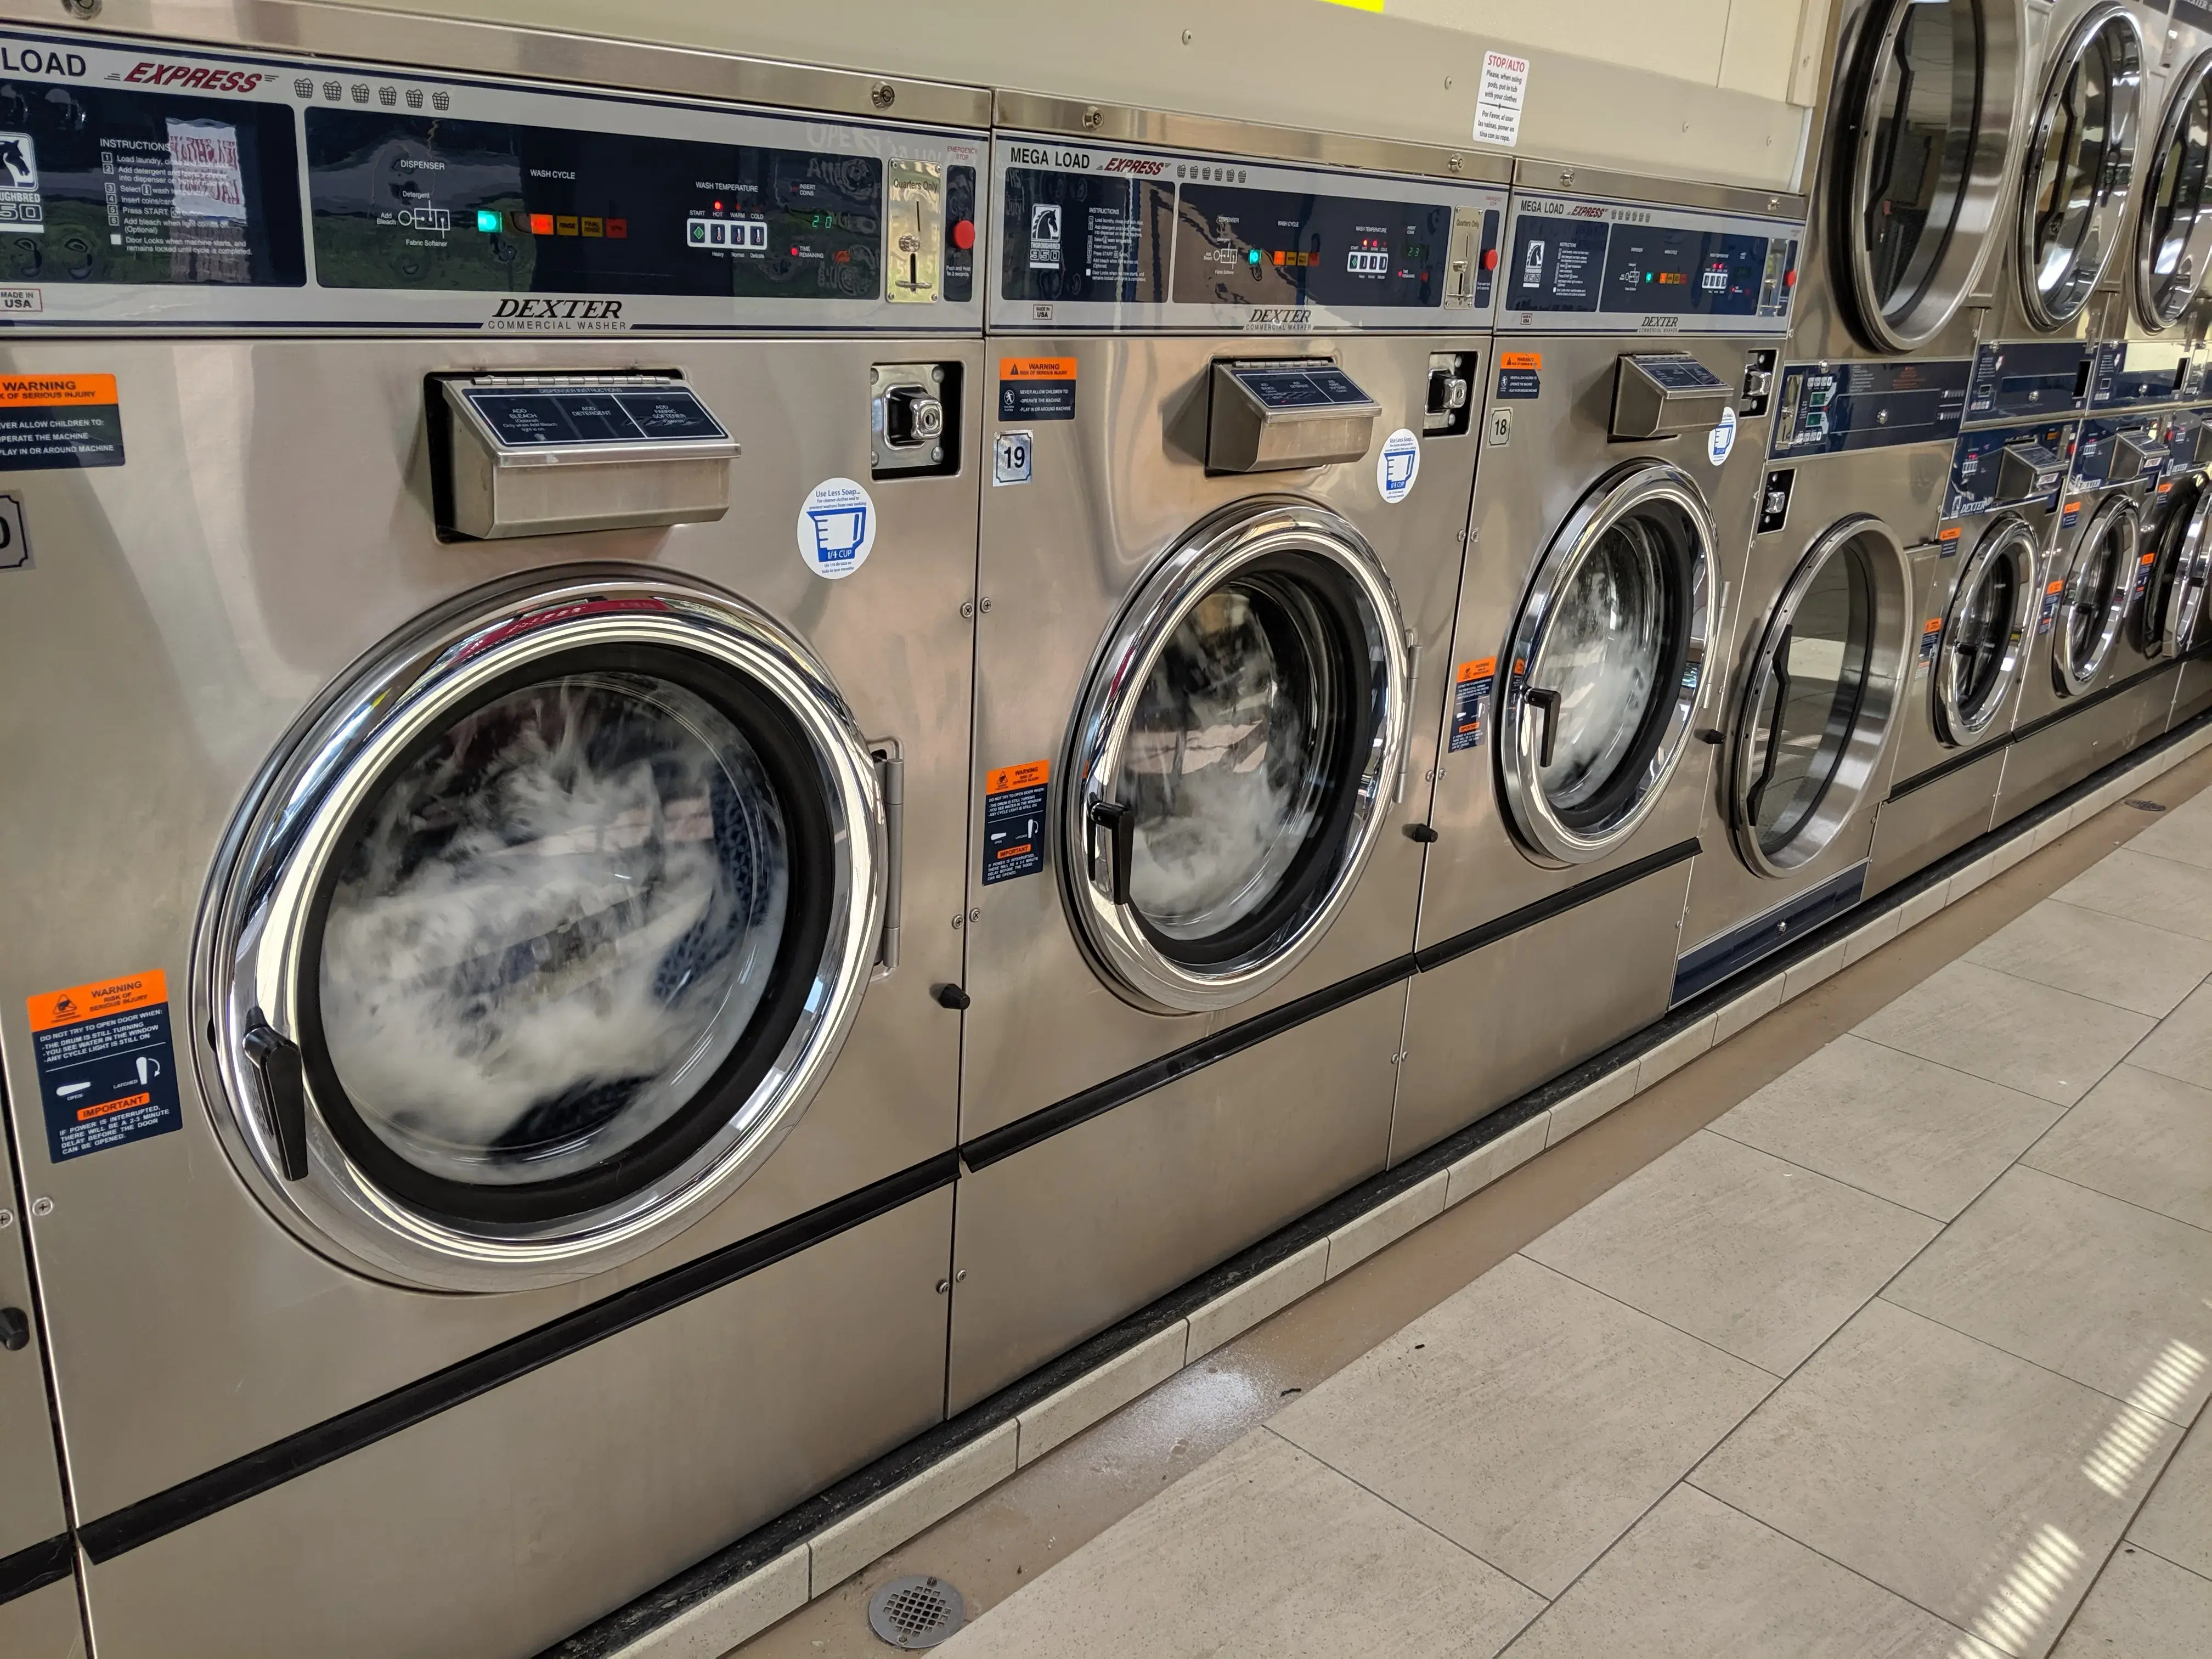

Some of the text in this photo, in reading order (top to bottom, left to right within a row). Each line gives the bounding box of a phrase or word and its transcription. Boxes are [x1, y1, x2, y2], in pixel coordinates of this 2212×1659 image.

[1, 47, 86, 77] LOAD
[1487, 54, 1525, 73] STOP/ALTO
[123, 62, 262, 93] EXPRESS
[1486, 70, 1499, 79] Please,
[1511, 76, 1522, 85] using
[1487, 82, 1498, 90] pods,
[1503, 94, 1517, 103] clothes
[1489, 112, 1500, 120] Favor,
[100, 138, 171, 152] INSTRUCTIONS
[947, 145, 977, 154] EMERGENCY
[117, 155, 134, 163] Load
[136, 156, 163, 166] laundry,
[1010, 146, 1090, 169] MEGA LOAD
[400, 160, 445, 170] DISPENSER
[1104, 157, 1165, 176] EXPRESS
[134, 167, 166, 176] detergent
[530, 170, 575, 180] WASH CYCLE
[133, 176, 166, 184] dispenser
[894, 179, 938, 191] Quarters Only
[695, 181, 759, 193] WASH TEMPERATURE
[121, 196, 140, 205] Insert
[402, 190, 430, 200] Detergent
[1520, 200, 1565, 215] MEGA LOAD
[1571, 206, 1605, 218] EXPRESS
[124, 226, 158, 234] (Optional)
[1457, 219, 1480, 230] Quarters Only
[424, 239, 448, 247] Softener
[1030, 249, 1060, 262] 950
[4, 299, 32, 308] USA
[492, 298, 622, 319] DEXTER
[1249, 309, 1312, 323] DEXTER
[488, 320, 626, 330] COMMERCIAL WASHER
[1641, 317, 1678, 328] DEXTER
[2, 381, 76, 391] WARNING
[50, 419, 90, 428] CHILDREN
[1494, 419, 1507, 436] 18
[52, 432, 89, 441] MACHINE
[29, 447, 42, 455] OR
[43, 445, 77, 454] AROUND
[1003, 446, 1025, 469] 19
[827, 549, 852, 560] 1/4 CUP
[91, 981, 142, 998] WARNING
[89, 994, 148, 1012] SERIOUS INJURY
[53, 1031, 69, 1040] NOT
[70, 1027, 84, 1036] TRY
[96, 1019, 116, 1029] OPEN
[117, 1014, 138, 1024] DOOR
[139, 1009, 163, 1019] WHEN:
[60, 1036, 82, 1046] DRUM
[92, 1030, 112, 1039] STILL
[112, 1022, 144, 1033] TURNING
[63, 1044, 78, 1052] SEE
[78, 1038, 104, 1050] WATER
[114, 1032, 128, 1040] THE
[128, 1024, 159, 1036] WINDOW
[63, 1048, 87, 1059] CYCLE
[88, 1043, 110, 1053] LIGHT
[119, 1036, 138, 1045] STILL
[83, 1096, 143, 1118] IMPORTANT
[69, 1121, 97, 1133] POWER
[110, 1105, 161, 1122] INTERRUPTED.
[60, 1132, 85, 1142] THERE
[88, 1126, 106, 1135] WILL
[143, 1109, 170, 1120] MINUTE
[61, 1118, 159, 1149] DELAY BEFORE THE DOOR
[62, 1146, 78, 1155] CAN
[94, 1133, 126, 1146] OPENED.
